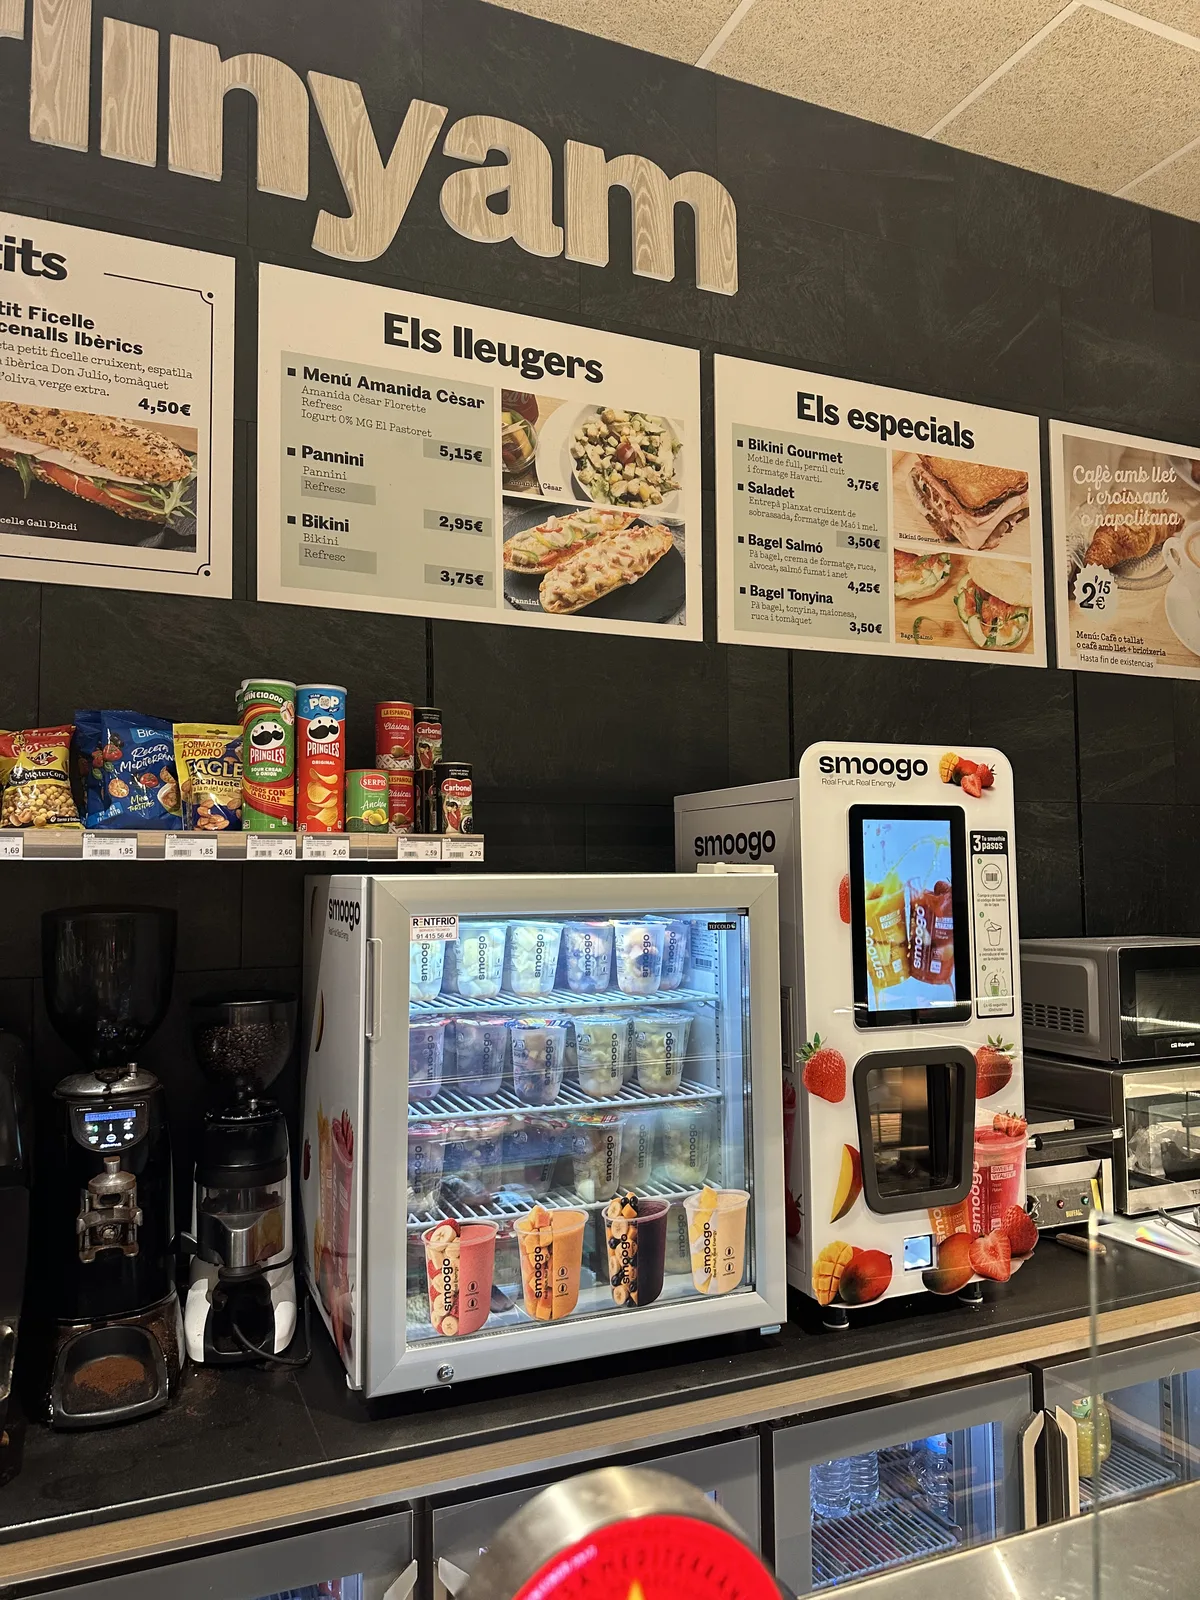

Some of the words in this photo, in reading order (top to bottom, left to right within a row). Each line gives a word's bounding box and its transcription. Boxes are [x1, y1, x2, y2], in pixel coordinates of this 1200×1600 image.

[0, 0, 737, 296] linyam
[0, 235, 68, 281] its
[28, 305, 95, 330] Ficelle
[75, 330, 144, 355] Ibèrics
[384, 312, 443, 354] Els
[453, 325, 604, 383] lleugers
[17, 343, 48, 357] petit
[50, 348, 88, 363] ficelle
[91, 354, 145, 374] cruixent,
[148, 363, 193, 380] espatlla
[6, 356, 49, 373] ibèrica
[51, 363, 75, 376] Don
[77, 367, 112, 383] Julio,
[114, 373, 169, 390] tomàquet
[38, 380, 72, 392] verge
[74, 384, 110, 397] extra.
[303, 366, 352, 387] Menú
[356, 375, 432, 401] Amanida
[436, 389, 485, 409] Cèsar
[138, 397, 191, 416] 4,50€
[301, 385, 350, 401] Amanida
[352, 394, 382, 406] Cèsar
[384, 398, 427, 414] Florette
[301, 397, 343, 411] Refresc
[301, 409, 337, 423] Iogurt
[339, 415, 353, 426] 0%
[356, 418, 373, 429] MG
[375, 420, 388, 431] El
[389, 422, 433, 438] Pastoret
[796, 391, 840, 425] Els
[847, 408, 975, 450] especials
[301, 445, 364, 467] Pannini
[439, 445, 483, 463] 5,15€
[748, 438, 783, 454] Bikini
[787, 444, 843, 464] Gourmet
[302, 465, 347, 481] Pannini
[747, 453, 773, 465] Motlle
[775, 456, 784, 466] de
[804, 462, 828, 473] pernil
[829, 465, 845, 475] cuit
[752, 465, 788, 480] formatge
[790, 471, 822, 483] Havarti.
[1072, 464, 1112, 490] Cafè
[1114, 467, 1149, 483] amb
[1151, 466, 1177, 483] llet
[304, 480, 346, 494] Refresc
[748, 481, 794, 498] Saladet
[847, 477, 879, 491] 3,75€
[1096, 489, 1169, 505] croissant
[749, 496, 781, 509] Entrepà
[782, 500, 812, 513] planxat
[813, 504, 846, 517] cruixent
[847, 509, 856, 518] de
[27, 518, 47, 528] Gall
[49, 520, 78, 531] Dindi
[302, 513, 349, 533] Bikini
[439, 515, 483, 533] 2,95€
[749, 508, 793, 522] sobrassada,
[794, 513, 829, 527] formatge
[830, 517, 839, 526] de
[841, 520, 856, 529] Maó
[862, 523, 878, 532] mel.
[1095, 509, 1181, 531] napolitana
[303, 532, 339, 546] Bikini
[748, 533, 782, 550] Bagel
[786, 538, 823, 554] Salmó
[847, 536, 880, 549] 3,50€
[304, 548, 346, 562] Refresc
[760, 551, 783, 562] bagel,
[784, 555, 808, 564] crema
[809, 556, 818, 565] de
[820, 557, 857, 570] formatge,
[857, 563, 877, 572] ruca,
[440, 570, 484, 586] 3,75€
[749, 562, 779, 573] alvocat,
[780, 565, 802, 574] salmó
[803, 567, 826, 577] fumat
[832, 571, 848, 579] anet
[750, 584, 784, 601] Bagel
[787, 588, 834, 605] Tonyina
[847, 581, 881, 594] 4,25€
[510, 596, 540, 605] Pannini
[762, 602, 785, 613] bagel,
[786, 605, 819, 617] tonyina,
[751, 613, 768, 621] ruca
[775, 614, 812, 626] tomàquet
[849, 622, 882, 635] 3,50€
[1123, 636, 1144, 645] tallat
[1080, 653, 1099, 663] Hasta
[1100, 654, 1109, 664] fin
[1110, 656, 1119, 665] de
[1120, 658, 1154, 669] existencias
[181, 748, 222, 758] AHORRO
[183, 741, 222, 749] FORMATO
[306, 741, 340, 758] PRINGLES
[250, 747, 285, 764] PRINGLES
[186, 759, 243, 780] EAGLE
[818, 755, 929, 781] smoogo
[362, 779, 386, 787] SERPIS
[821, 777, 836, 786] Real
[268, 789, 286, 797] CON
[4, 847, 20, 855] 1,69
[119, 847, 134, 855] 1,95
[199, 848, 214, 856] 1,85
[694, 830, 776, 860] smoogo
[973, 834, 982, 852] 3
[982, 842, 1003, 852] pasos
[328, 898, 361, 931] smoogo
[412, 916, 456, 926] RENTFRIO
[913, 905, 927, 969] smoogo
[421, 942, 430, 981] smoog
[478, 935, 487, 980] smoogo
[534, 934, 544, 978] smoogo
[584, 933, 593, 977] smoogo
[642, 934, 652, 978] smoogo
[605, 1135, 614, 1182] smoogo
[703, 1222, 713, 1274] smoogo
[620, 1233, 630, 1284] smoogo
[534, 1246, 544, 1298] smoogo
[442, 1258, 453, 1312] smoogo
